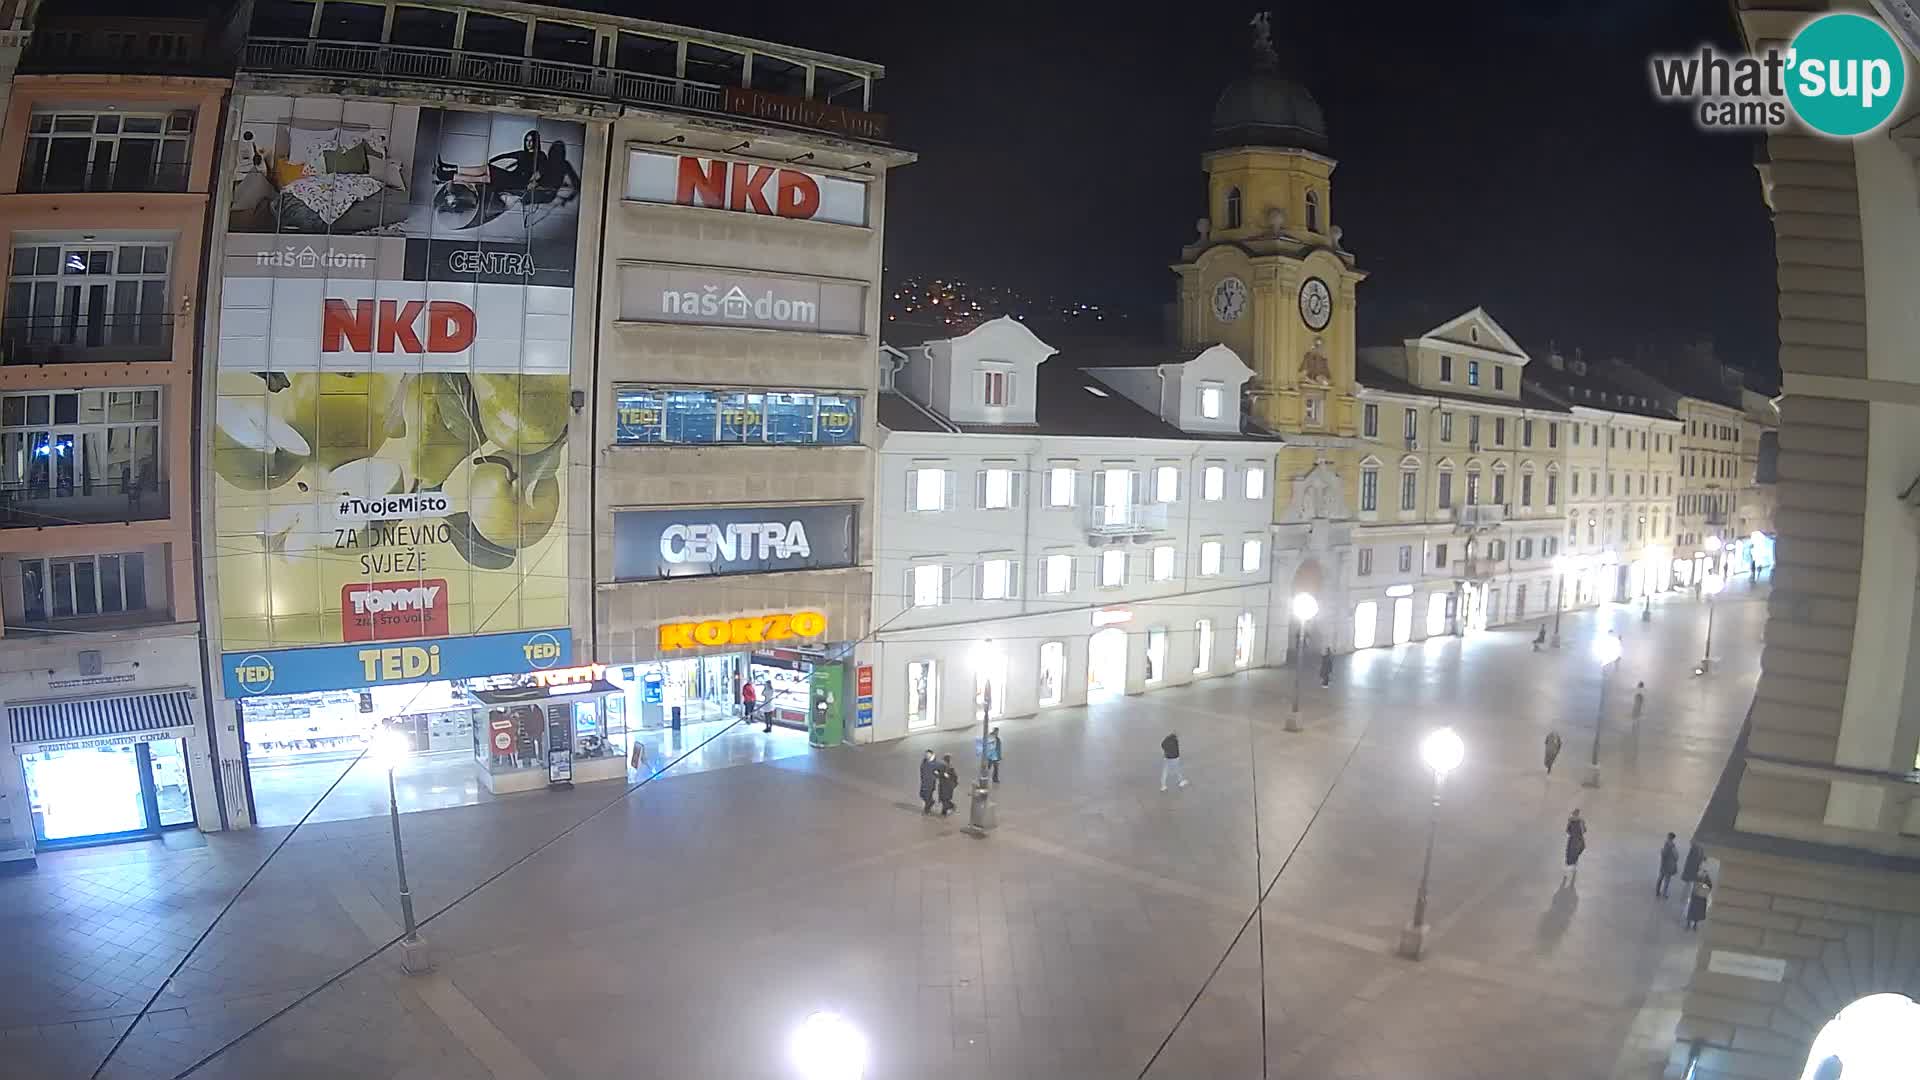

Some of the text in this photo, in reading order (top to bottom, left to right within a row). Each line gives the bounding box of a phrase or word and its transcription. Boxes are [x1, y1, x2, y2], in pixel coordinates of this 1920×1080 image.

[677, 156, 820, 219] NKD
[256, 246, 367, 268] naš dom
[449, 250, 536, 276] CENTRA
[662, 284, 816, 323] naš dom
[322, 298, 478, 353] NKD
[340, 498, 447, 516] #TvojeMisto
[335, 523, 451, 549] ZA DNEVNO
[660, 520, 810, 564] CENTRA
[361, 547, 427, 575] SVJEŽE
[350, 586, 440, 614] TOMMY
[658, 612, 826, 651] KORZO
[359, 644, 440, 681] TEDi
[523, 641, 561, 660] TEDi
[235, 664, 274, 683] TEDi
